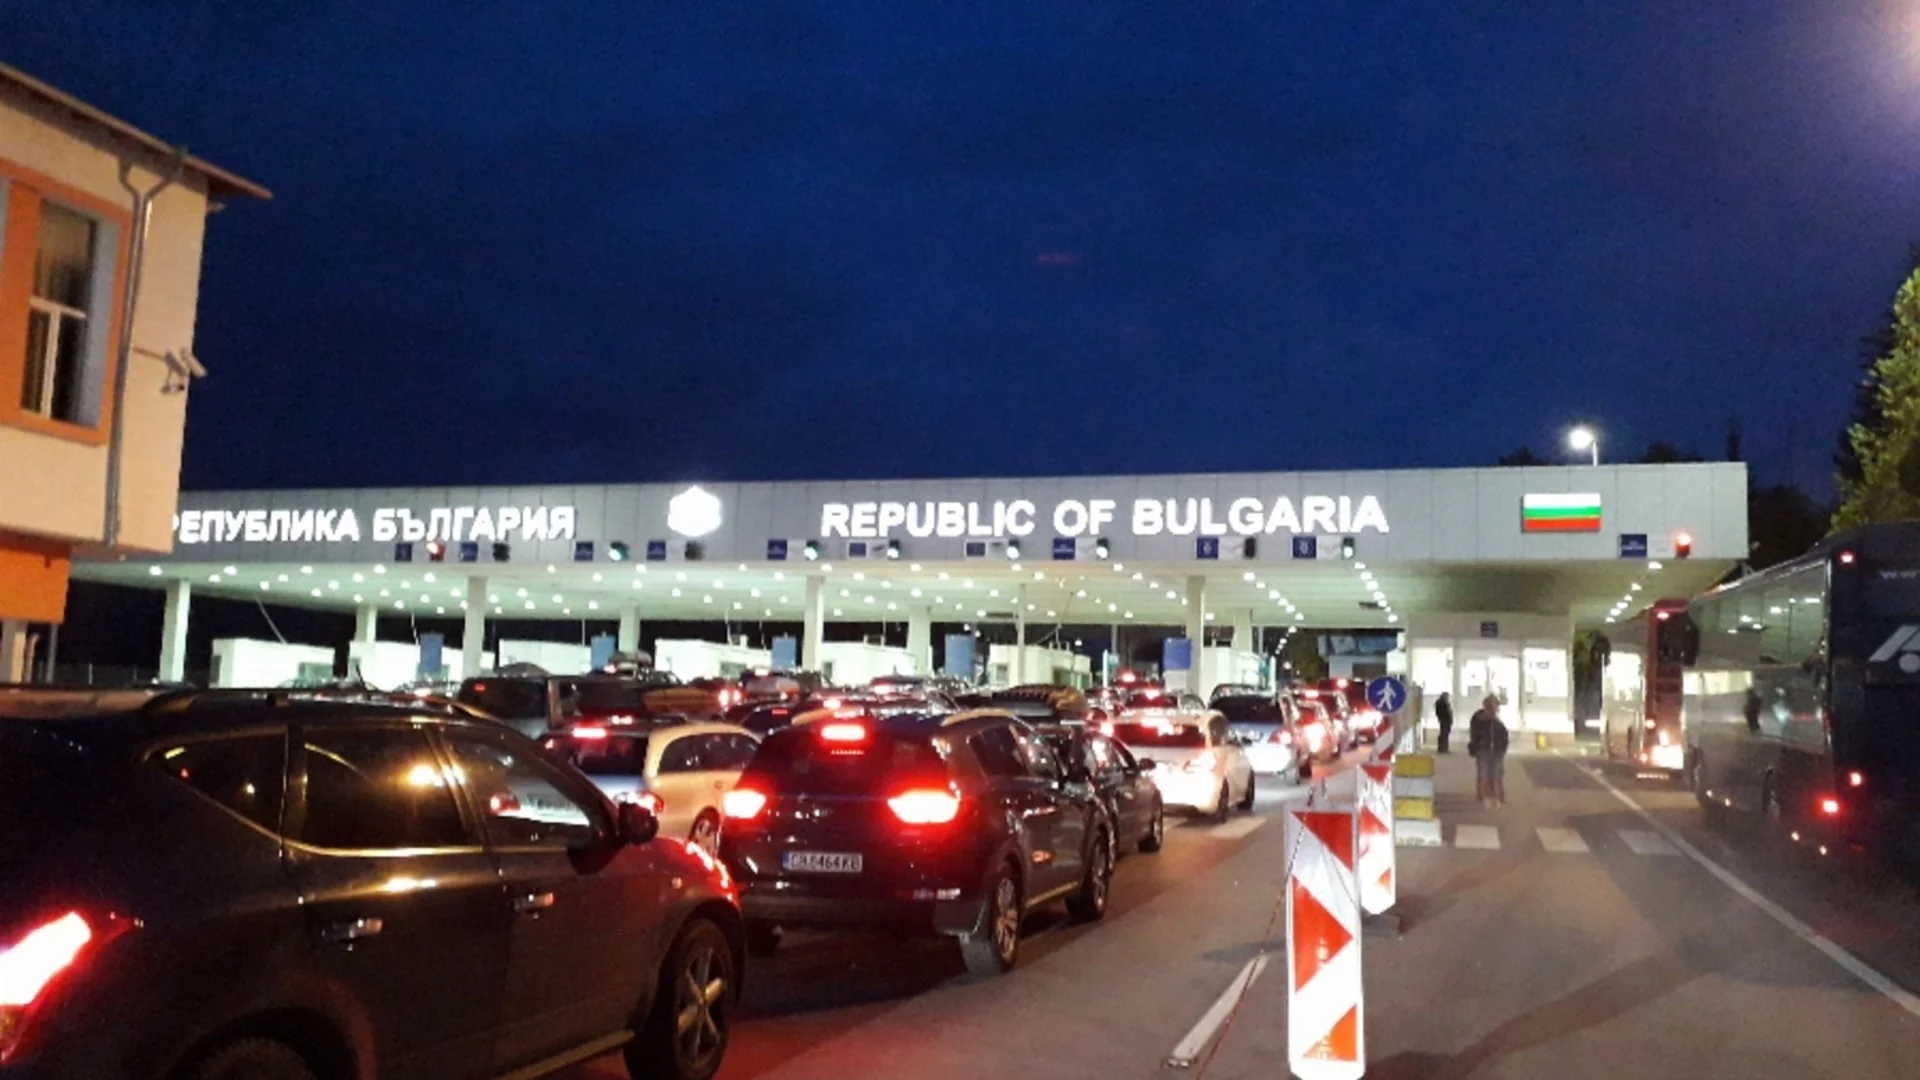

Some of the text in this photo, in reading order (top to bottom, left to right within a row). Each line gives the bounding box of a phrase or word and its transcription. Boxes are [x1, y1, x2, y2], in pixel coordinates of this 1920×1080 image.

[373, 506, 575, 541] БЪЛГАРИЯ
[821, 495, 1389, 537] REPUBLIC OF BULGARIA
